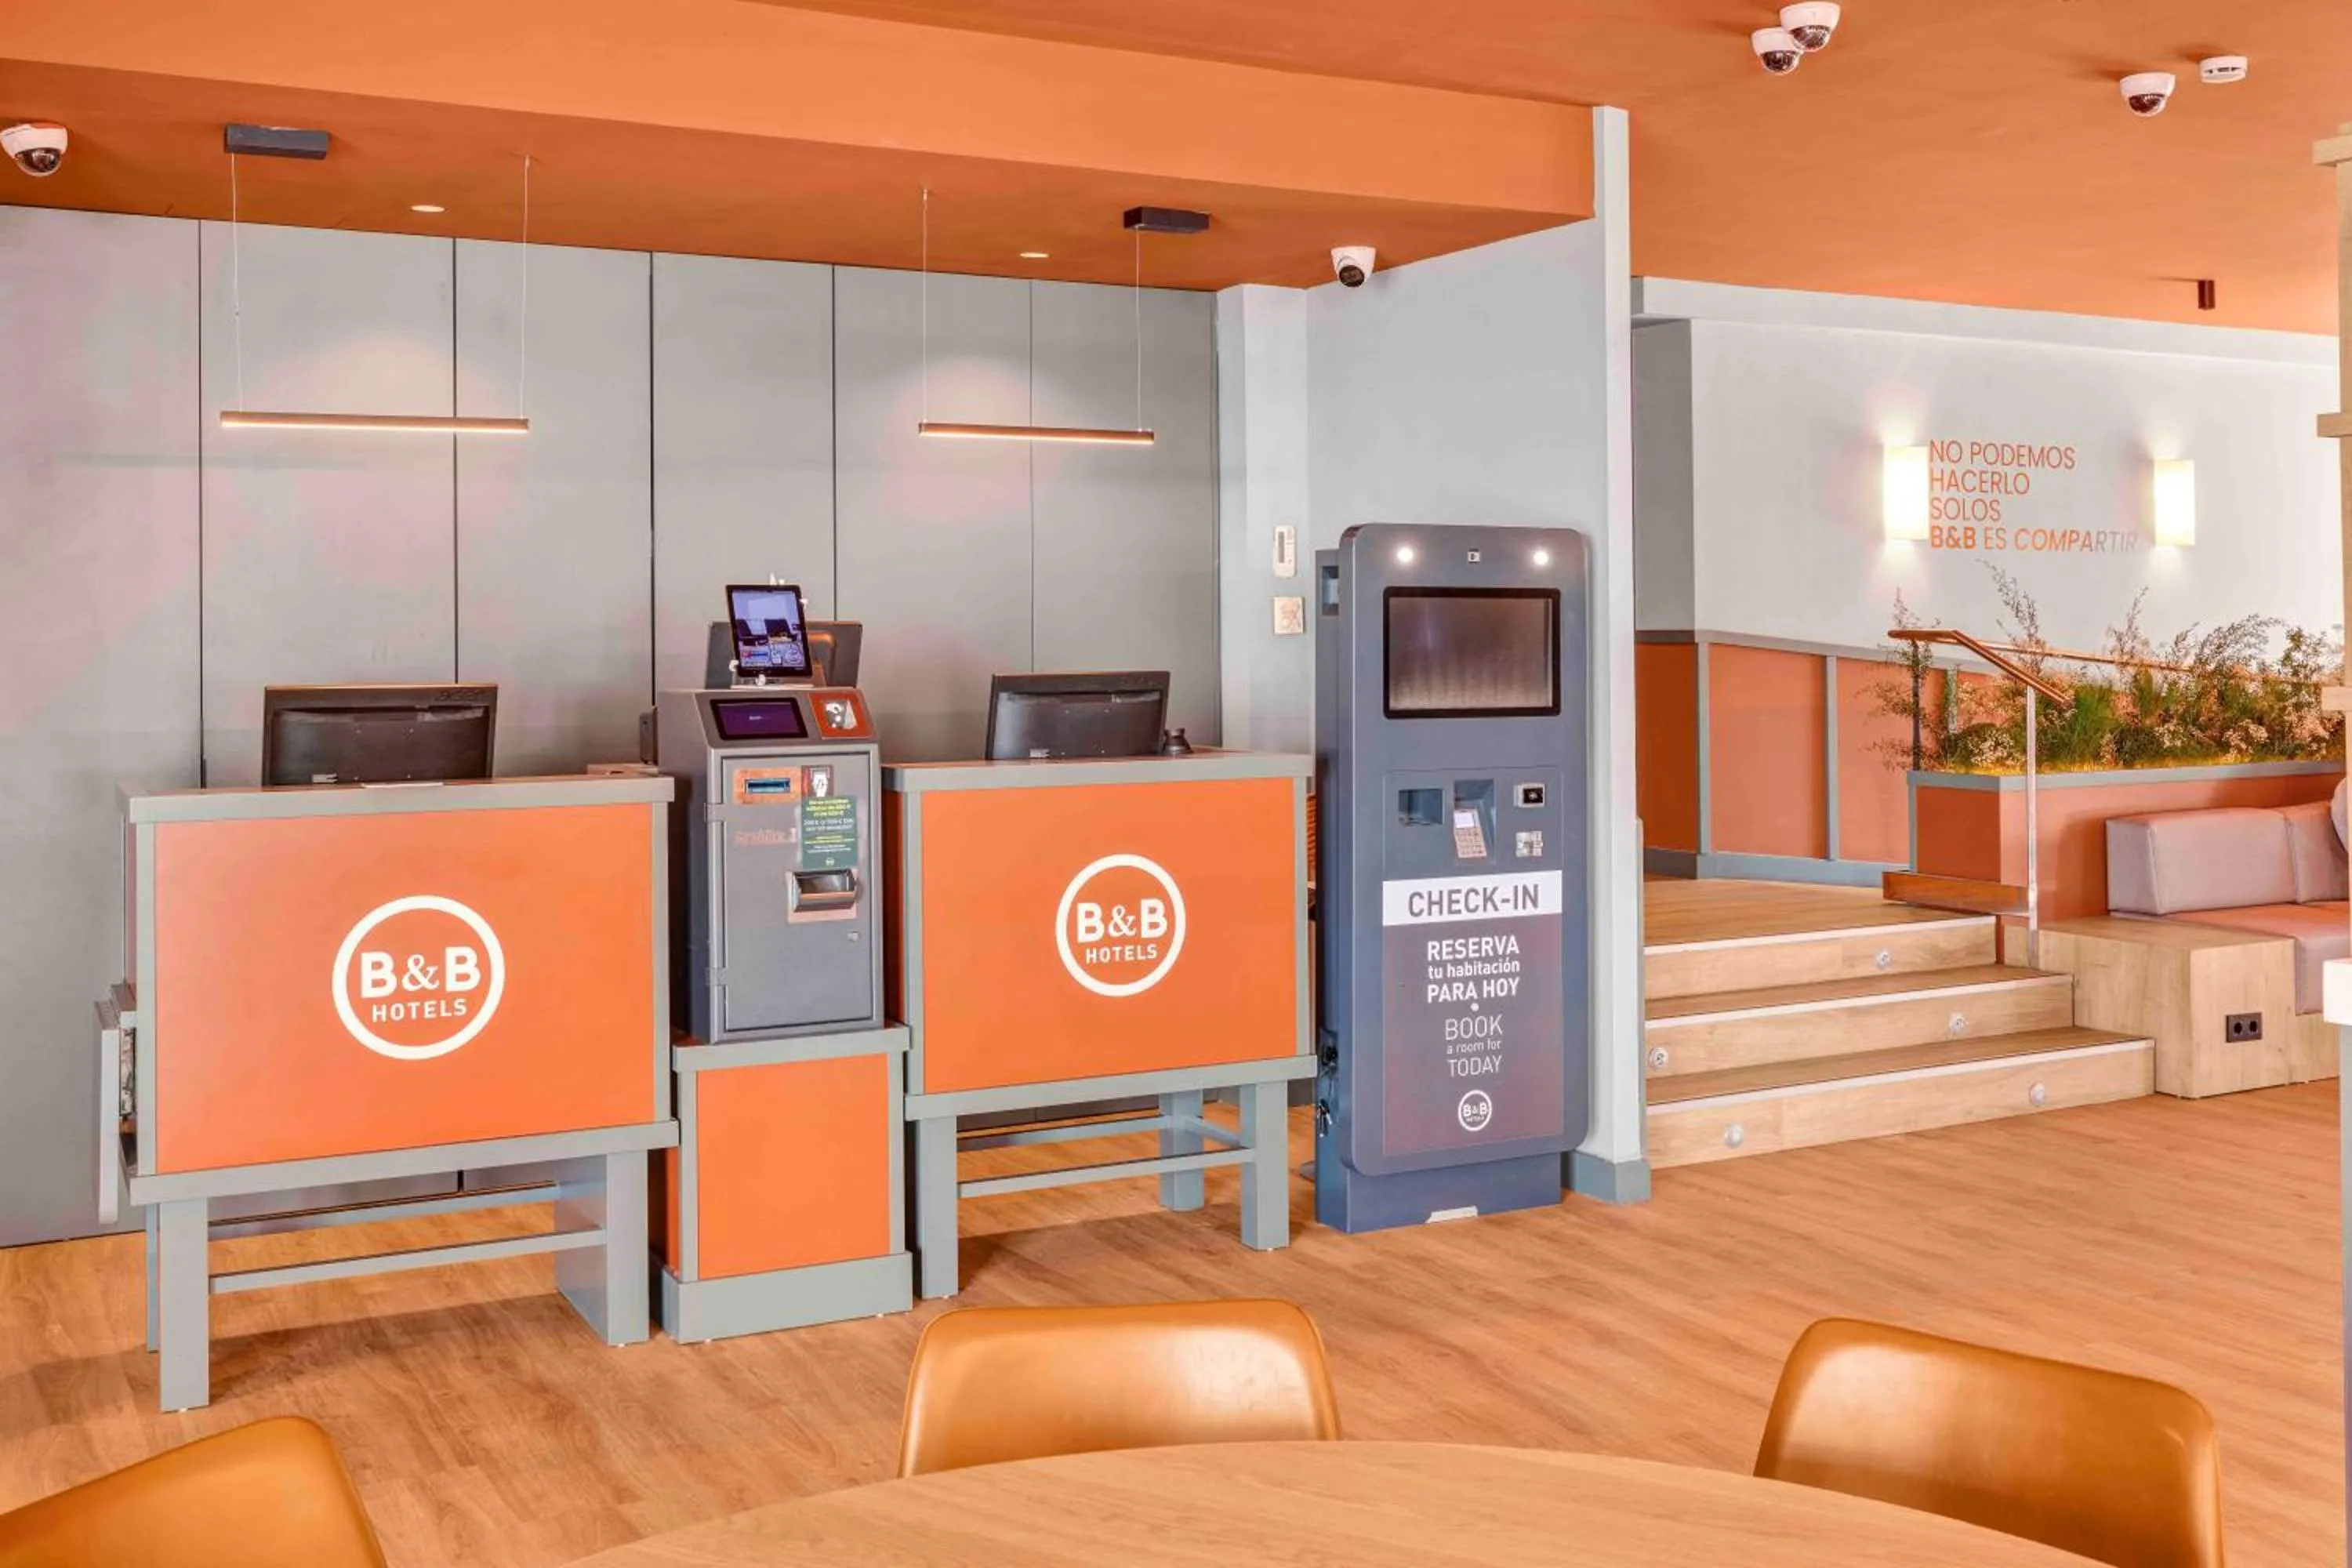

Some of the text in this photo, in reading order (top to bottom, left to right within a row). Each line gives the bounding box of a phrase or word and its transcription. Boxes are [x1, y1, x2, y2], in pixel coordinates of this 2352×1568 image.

[1929, 439, 2076, 470] NO PODEMOS
[1929, 468, 2030, 495] HACERLO
[1929, 497, 2001, 522] SOLOS
[1930, 525, 2138, 554] B&B ES COMPARTIR
[1408, 884, 1540, 918] CHECK-IN
[1076, 897, 1168, 944] B&B
[1085, 943, 1158, 965] HOTELS
[1427, 935, 1520, 962] RESERVA
[361, 946, 481, 999] B&B
[1428, 956, 1521, 979] tu habitación
[1427, 977, 1520, 1004] PARA HOY
[372, 998, 468, 1023] HOTELS
[1445, 1013, 1504, 1040] BOOK
[1446, 1038, 1502, 1054] a room for
[1447, 1054, 1503, 1078] TODAY
[1462, 1102, 1488, 1117] B&B
